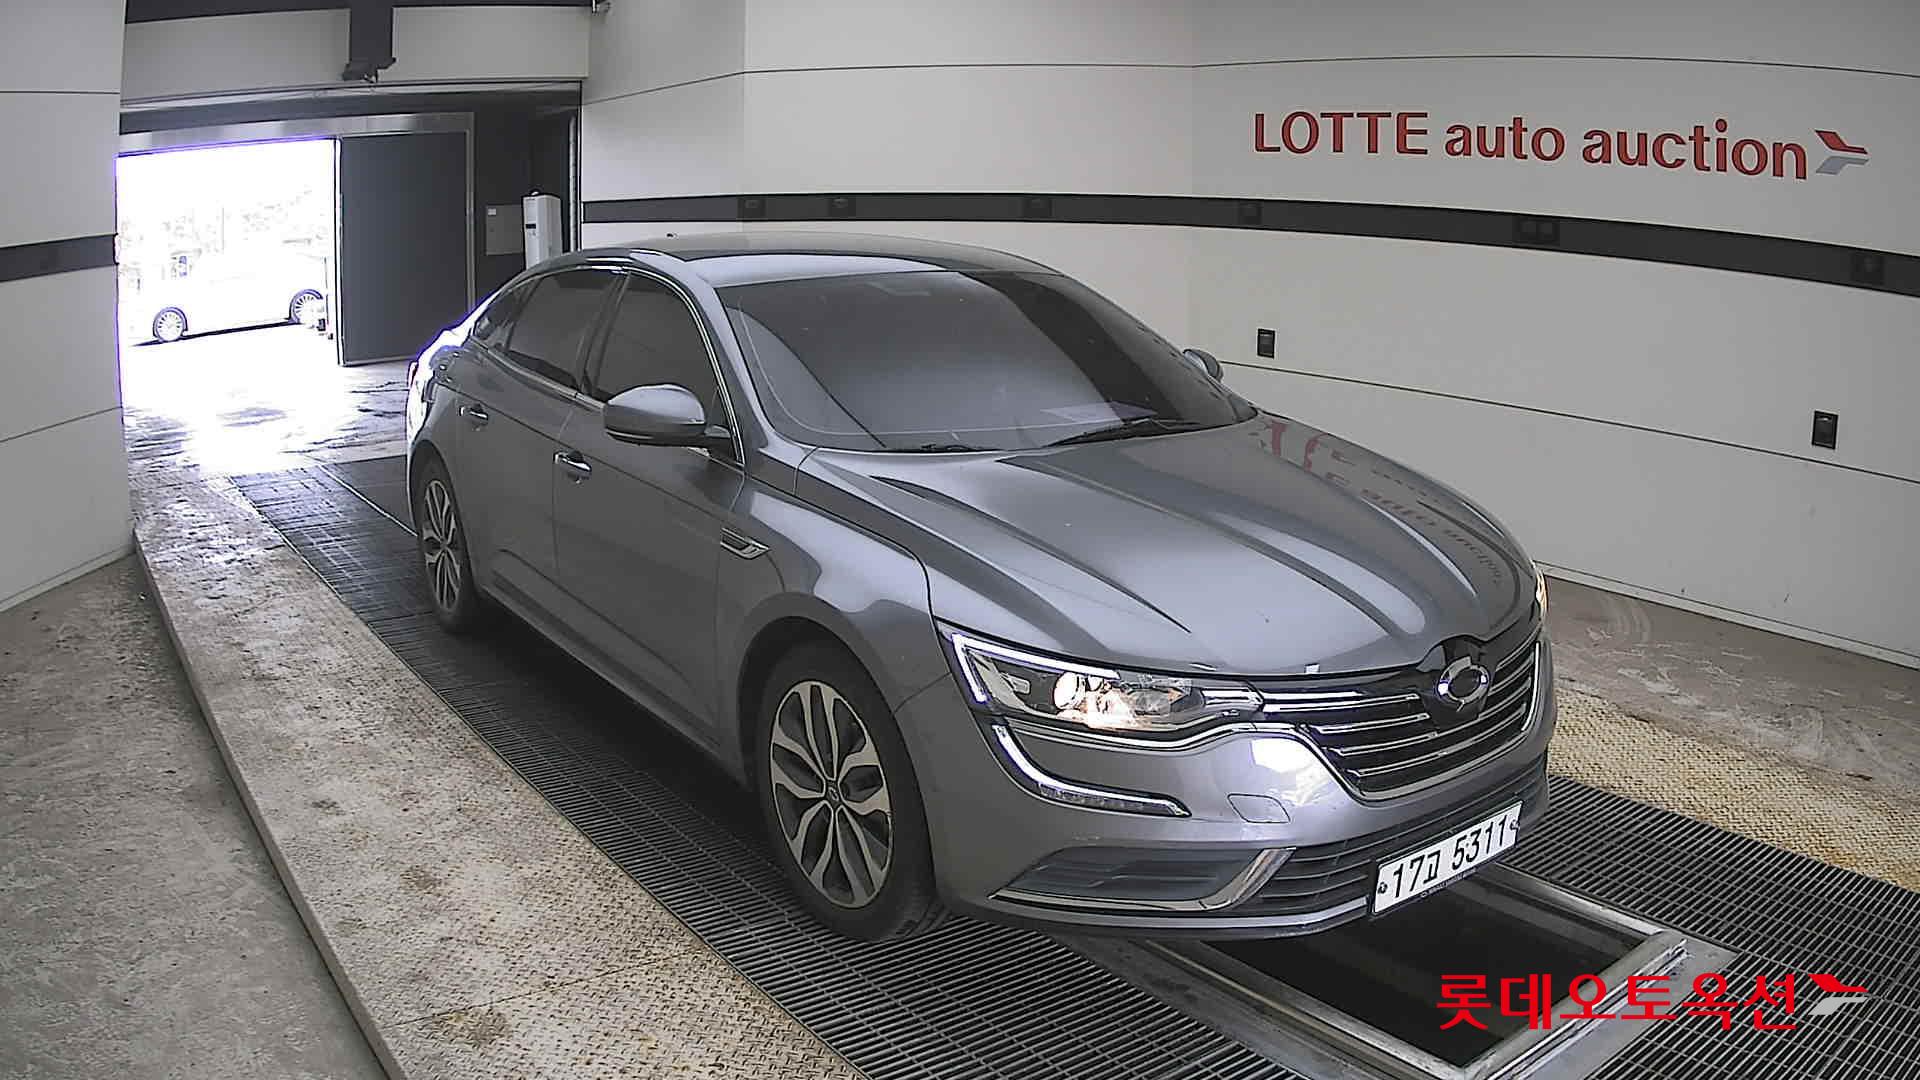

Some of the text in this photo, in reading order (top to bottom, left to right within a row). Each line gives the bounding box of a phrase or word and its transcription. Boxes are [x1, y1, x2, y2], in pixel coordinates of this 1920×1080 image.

[1254, 111, 1808, 180] LOTTE auto auction
[1393, 849, 1441, 898] 17고
[1452, 815, 1508, 871] 5311
